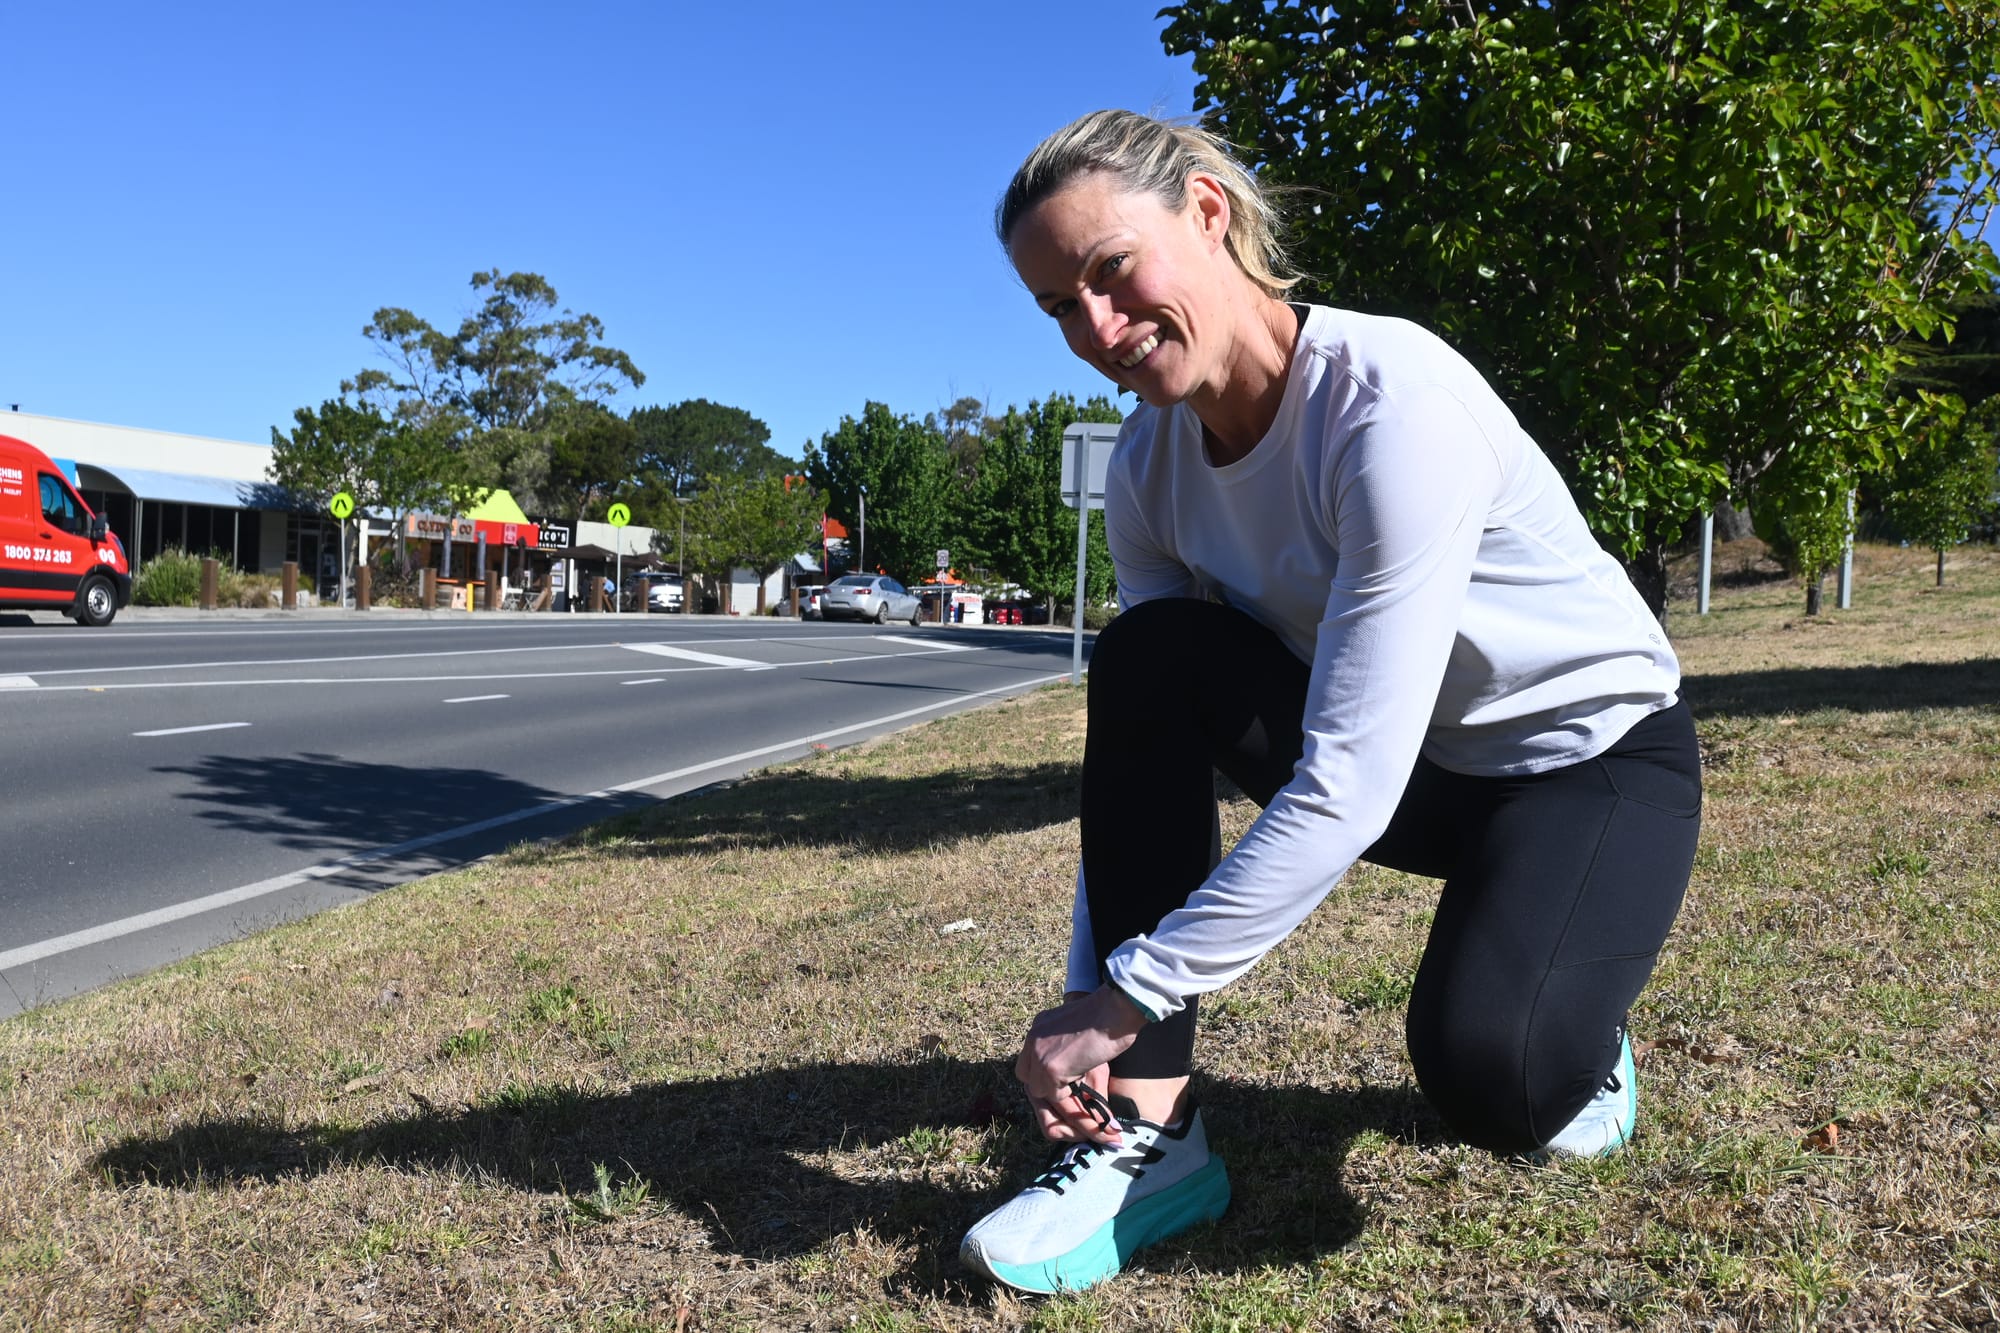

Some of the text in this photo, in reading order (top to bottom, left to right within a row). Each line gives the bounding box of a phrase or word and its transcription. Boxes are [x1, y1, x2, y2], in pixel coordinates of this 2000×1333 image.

[417, 519, 472, 535] CLYD CO
[4, 545, 31, 560] 1800
[53, 549, 72, 564] 263
